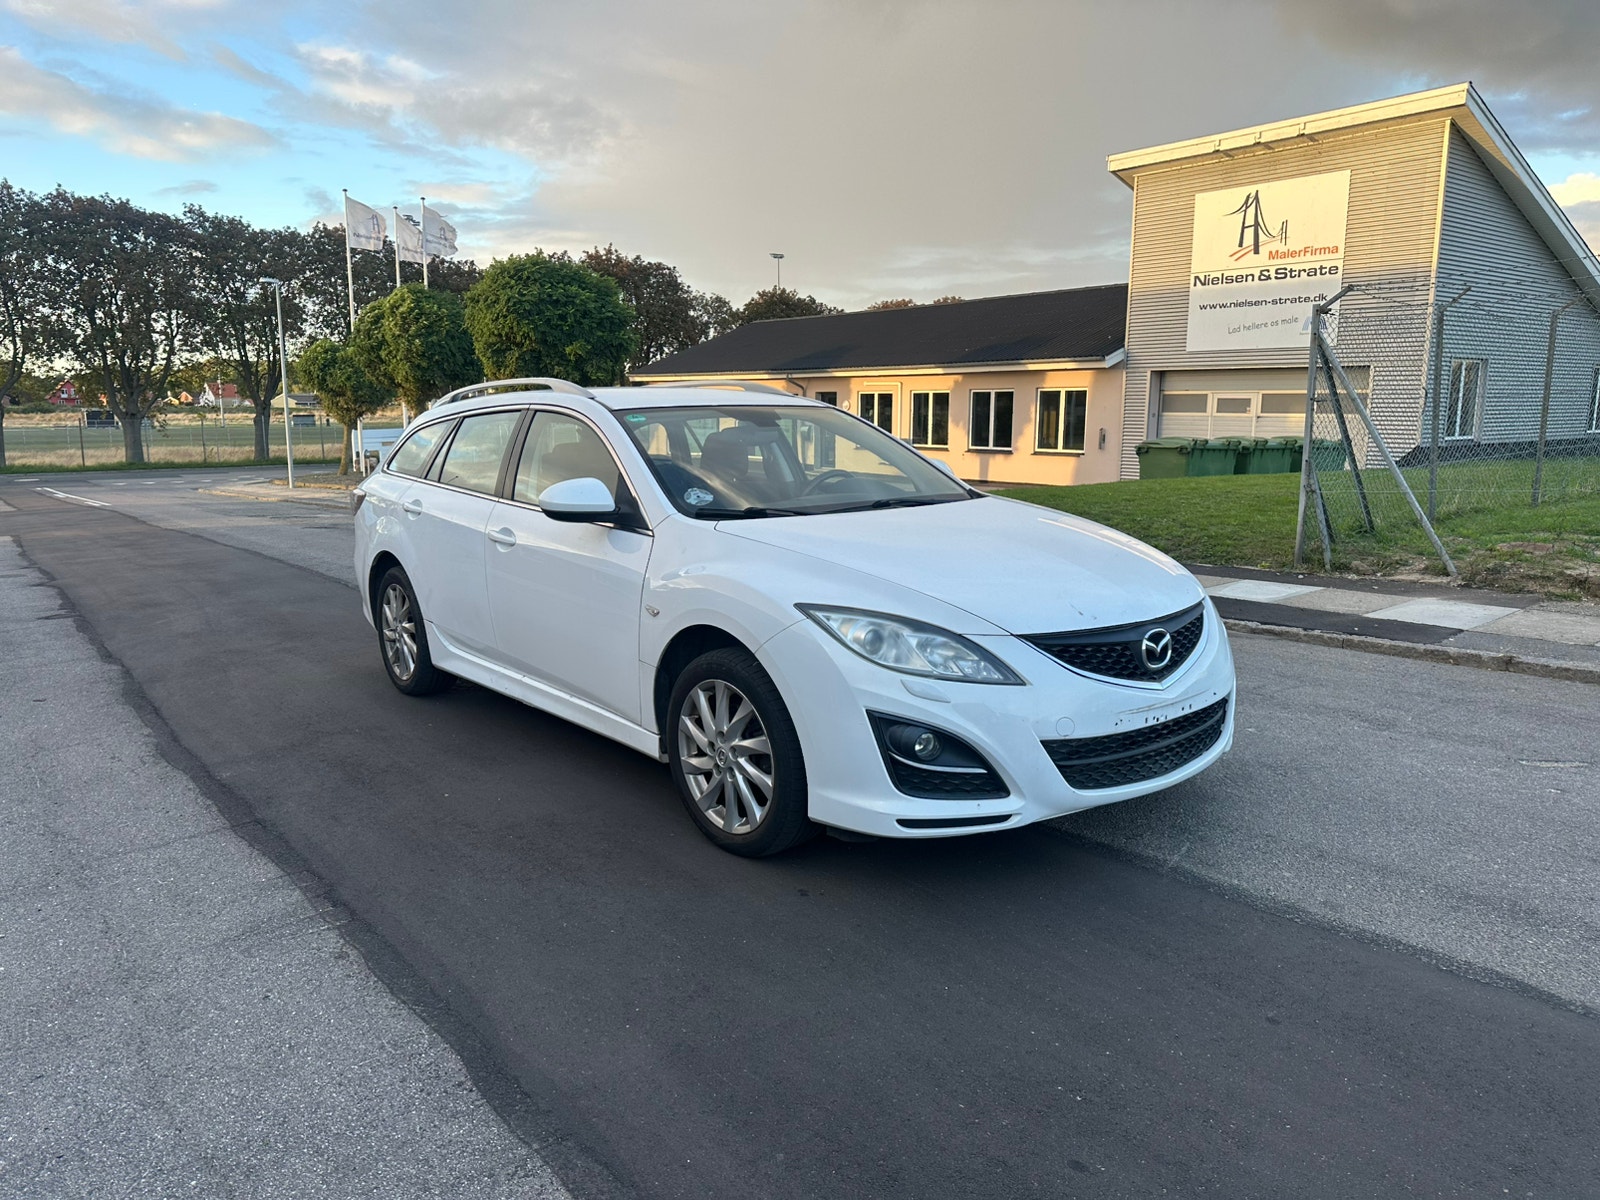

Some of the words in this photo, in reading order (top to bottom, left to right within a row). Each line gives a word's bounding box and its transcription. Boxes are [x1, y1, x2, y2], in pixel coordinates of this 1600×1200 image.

[1268, 245, 1339, 261] MalerFirma
[1193, 272, 1255, 287] Nielsen
[1257, 269, 1272, 282] &
[1274, 264, 1339, 280] Strate
[1199, 293, 1328, 310] www.nielsen-strate.dk
[1243, 320, 1269, 331] hellere
